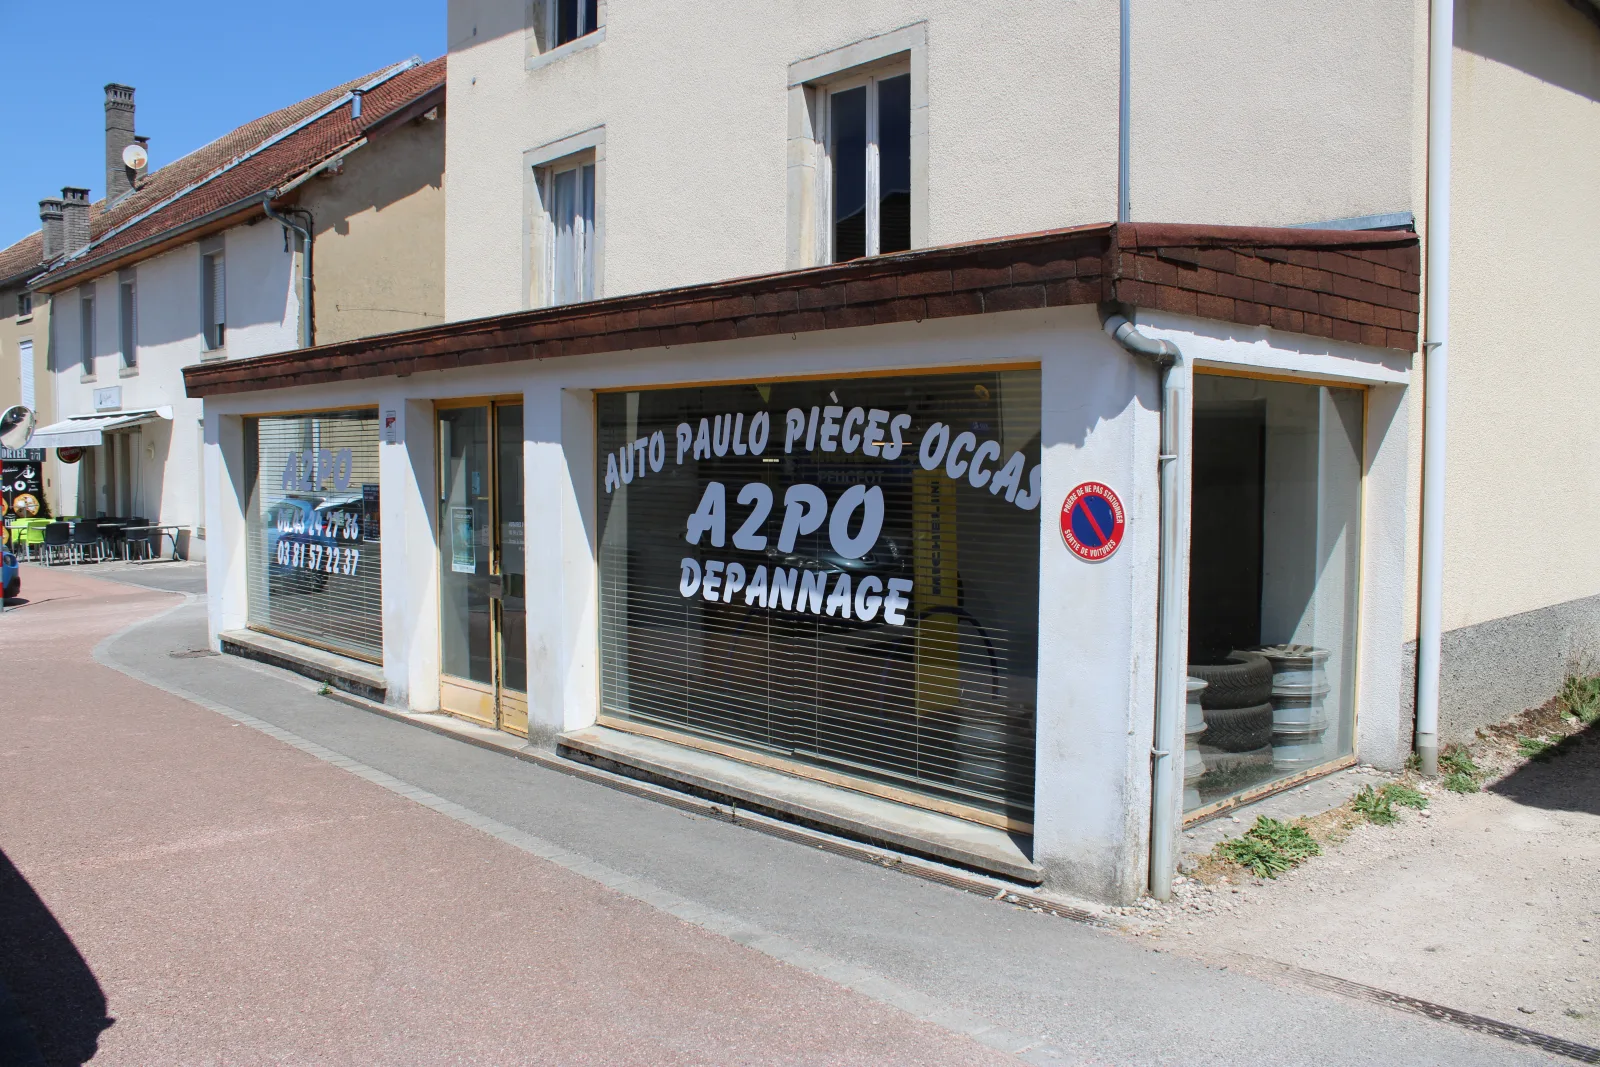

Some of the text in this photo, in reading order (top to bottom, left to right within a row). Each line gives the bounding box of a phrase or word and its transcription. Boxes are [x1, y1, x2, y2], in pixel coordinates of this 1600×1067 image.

[282, 448, 352, 491] A2PO
[604, 390, 1042, 511] AUTO PAULO PIÈCES OCCAS
[818, 470, 884, 484] PEUGEOT
[686, 481, 885, 559] A2PO
[1077, 488, 1084, 496] DE
[1093, 485, 1103, 494] PAS
[1103, 489, 1124, 524] STATIONNER
[308, 511, 323, 536] 24
[325, 511, 339, 538] 27
[342, 512, 359, 540] 36
[930, 480, 941, 595] MICHELIN
[1064, 529, 1116, 557] SORTIE DE VOITURES
[278, 541, 360, 576] 03 81 57 22 37
[679, 557, 914, 626] DEPANNAGE
